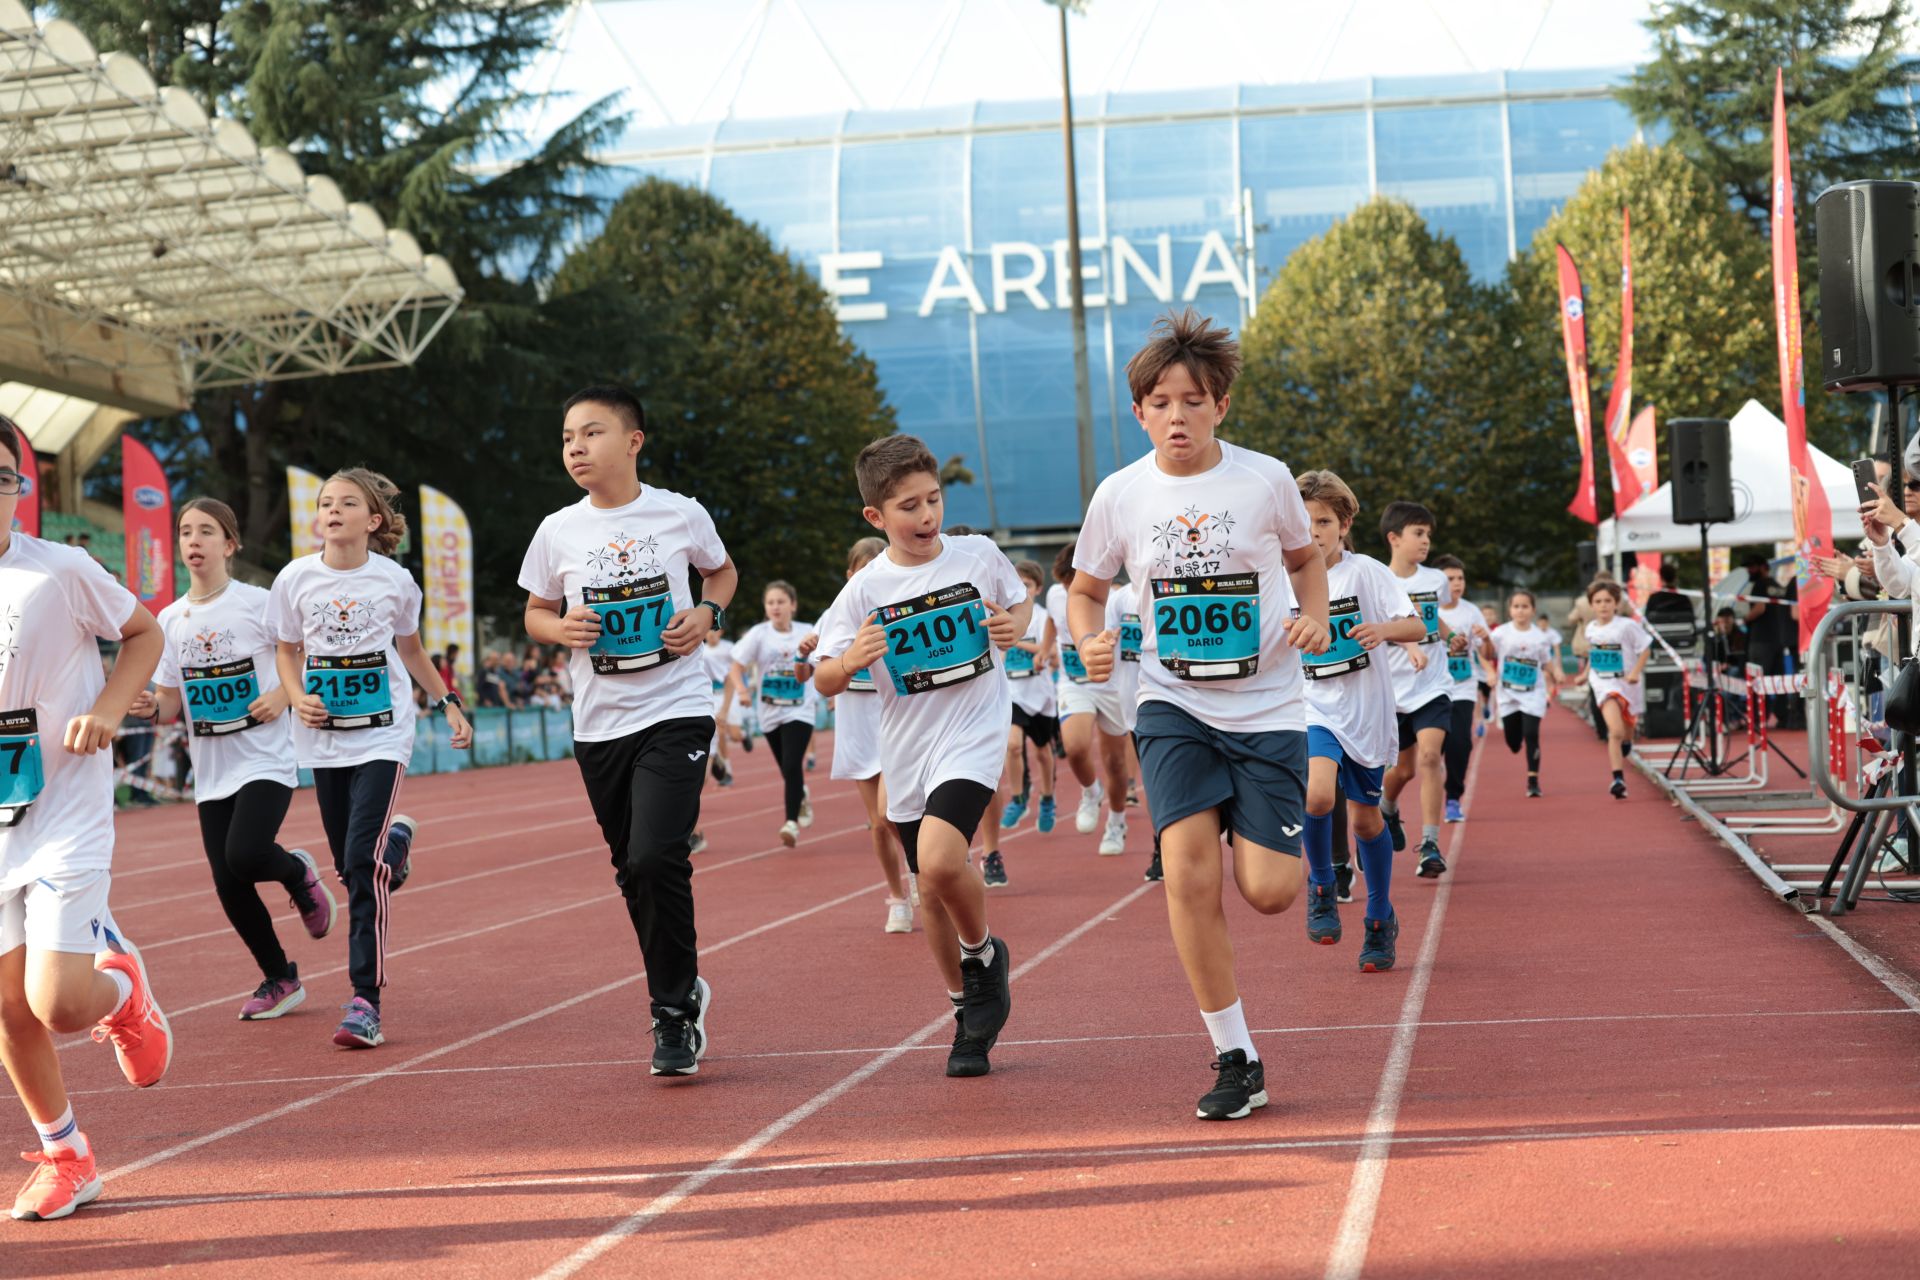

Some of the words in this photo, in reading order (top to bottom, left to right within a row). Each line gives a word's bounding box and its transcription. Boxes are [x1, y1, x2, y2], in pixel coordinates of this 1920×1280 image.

[918, 230, 1250, 318] ARENA
[1174, 561, 1200, 575] BISS
[1202, 561, 1220, 574] 17
[1157, 601, 1252, 636] 2066
[889, 607, 976, 656] 2101
[617, 635, 642, 645] IKER
[1187, 637, 1223, 647] DARIO
[927, 645, 954, 659] JOSU
[187, 678, 252, 705] 2009
[308, 672, 381, 698] 2159
[331, 699, 359, 707] ELENA
[6, 717, 30, 725] KUTXA
